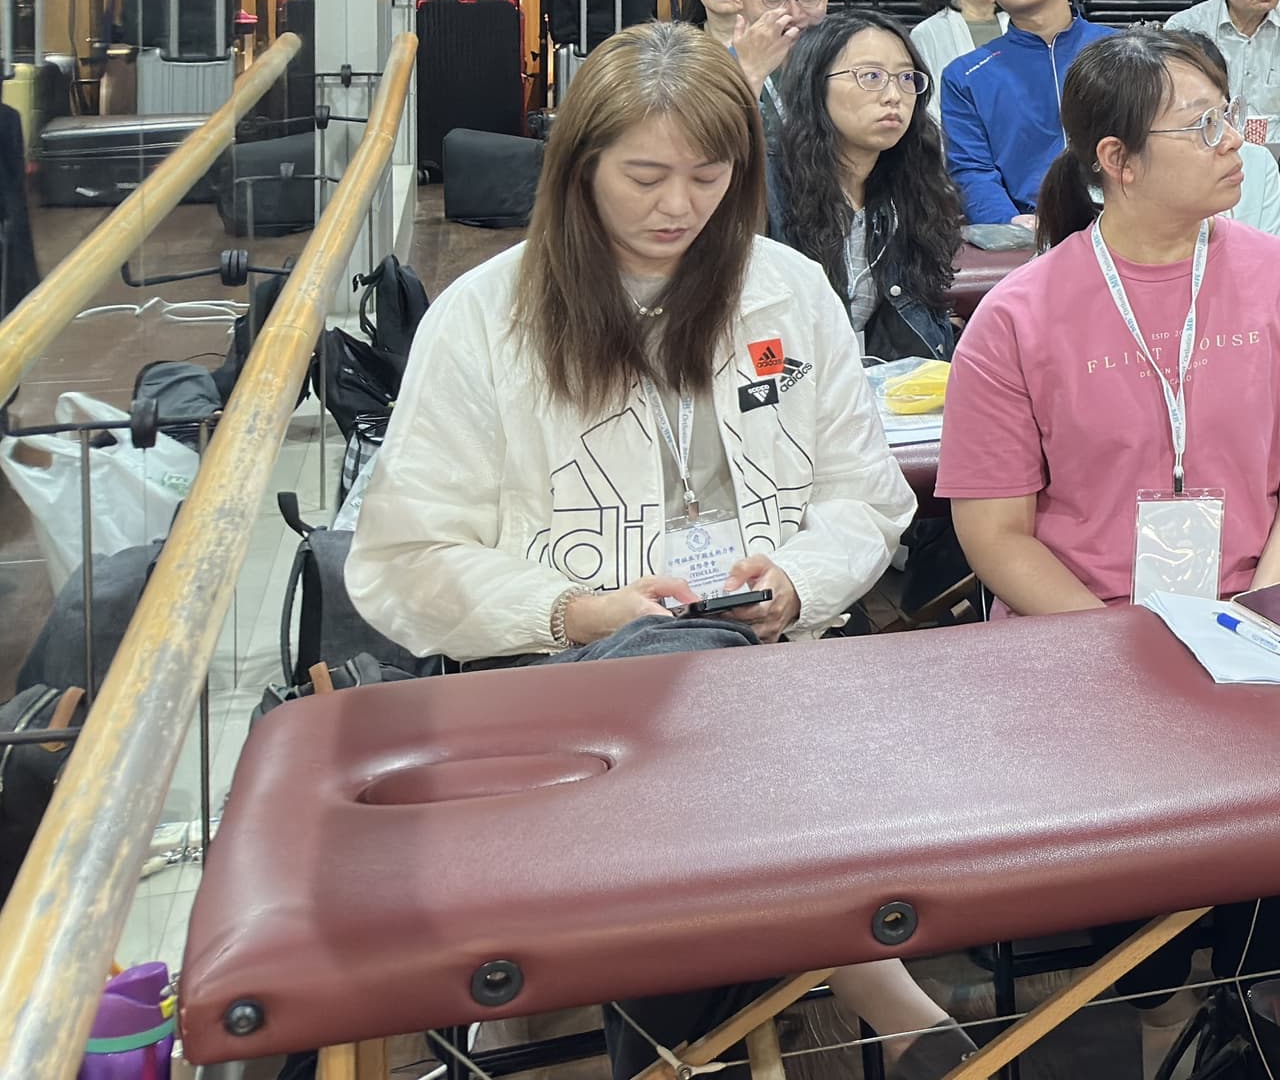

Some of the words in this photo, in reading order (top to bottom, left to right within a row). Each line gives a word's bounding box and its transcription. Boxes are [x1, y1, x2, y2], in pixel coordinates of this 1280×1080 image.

[1151, 331, 1170, 341] ESTD
[1087, 347, 1162, 374] FLINT
[1199, 330, 1260, 351] OUSE
[756, 359, 783, 369] adidas
[780, 362, 813, 392] adidas
